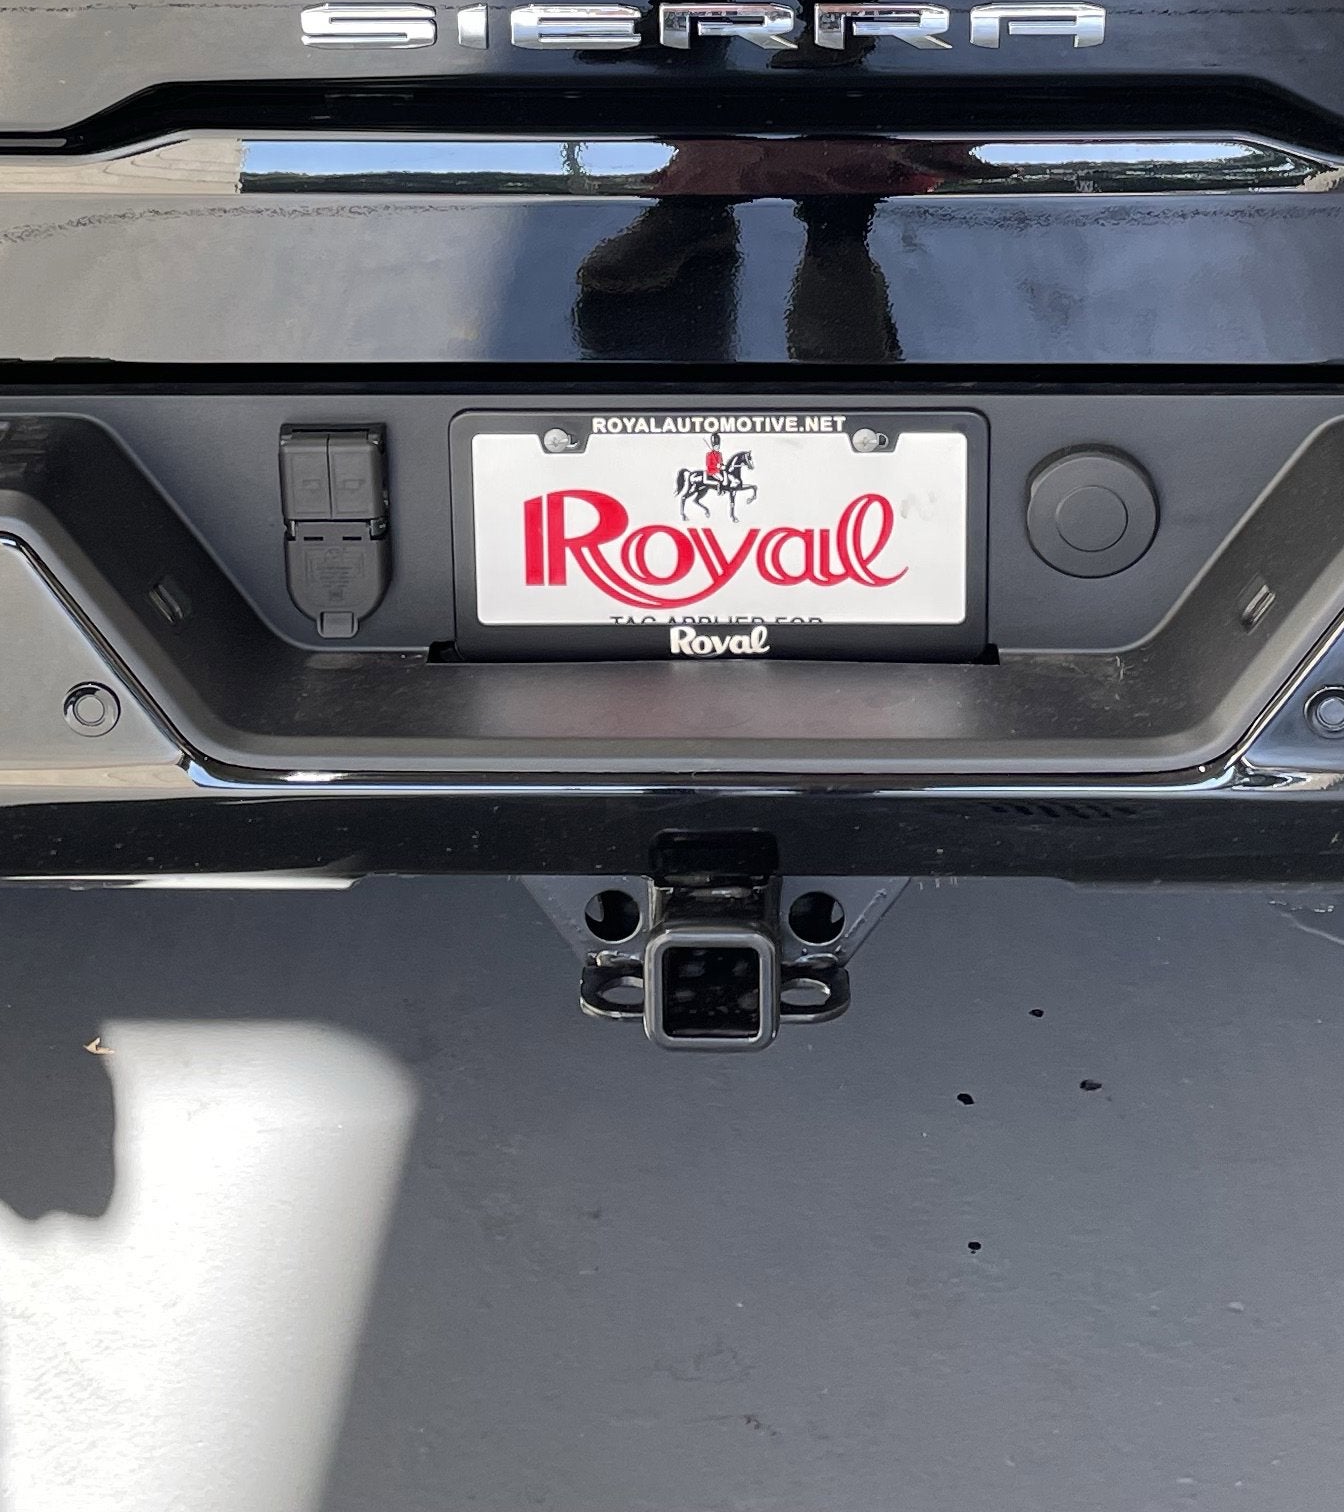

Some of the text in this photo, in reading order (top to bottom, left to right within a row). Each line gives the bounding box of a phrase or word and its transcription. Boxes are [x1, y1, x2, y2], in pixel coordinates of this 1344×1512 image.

[300, 1, 1108, 51] SIERRA
[591, 415, 847, 434] ROYALAUTOMOTIVE.NET
[523, 488, 909, 610] Royal
[669, 625, 771, 656] Royal
